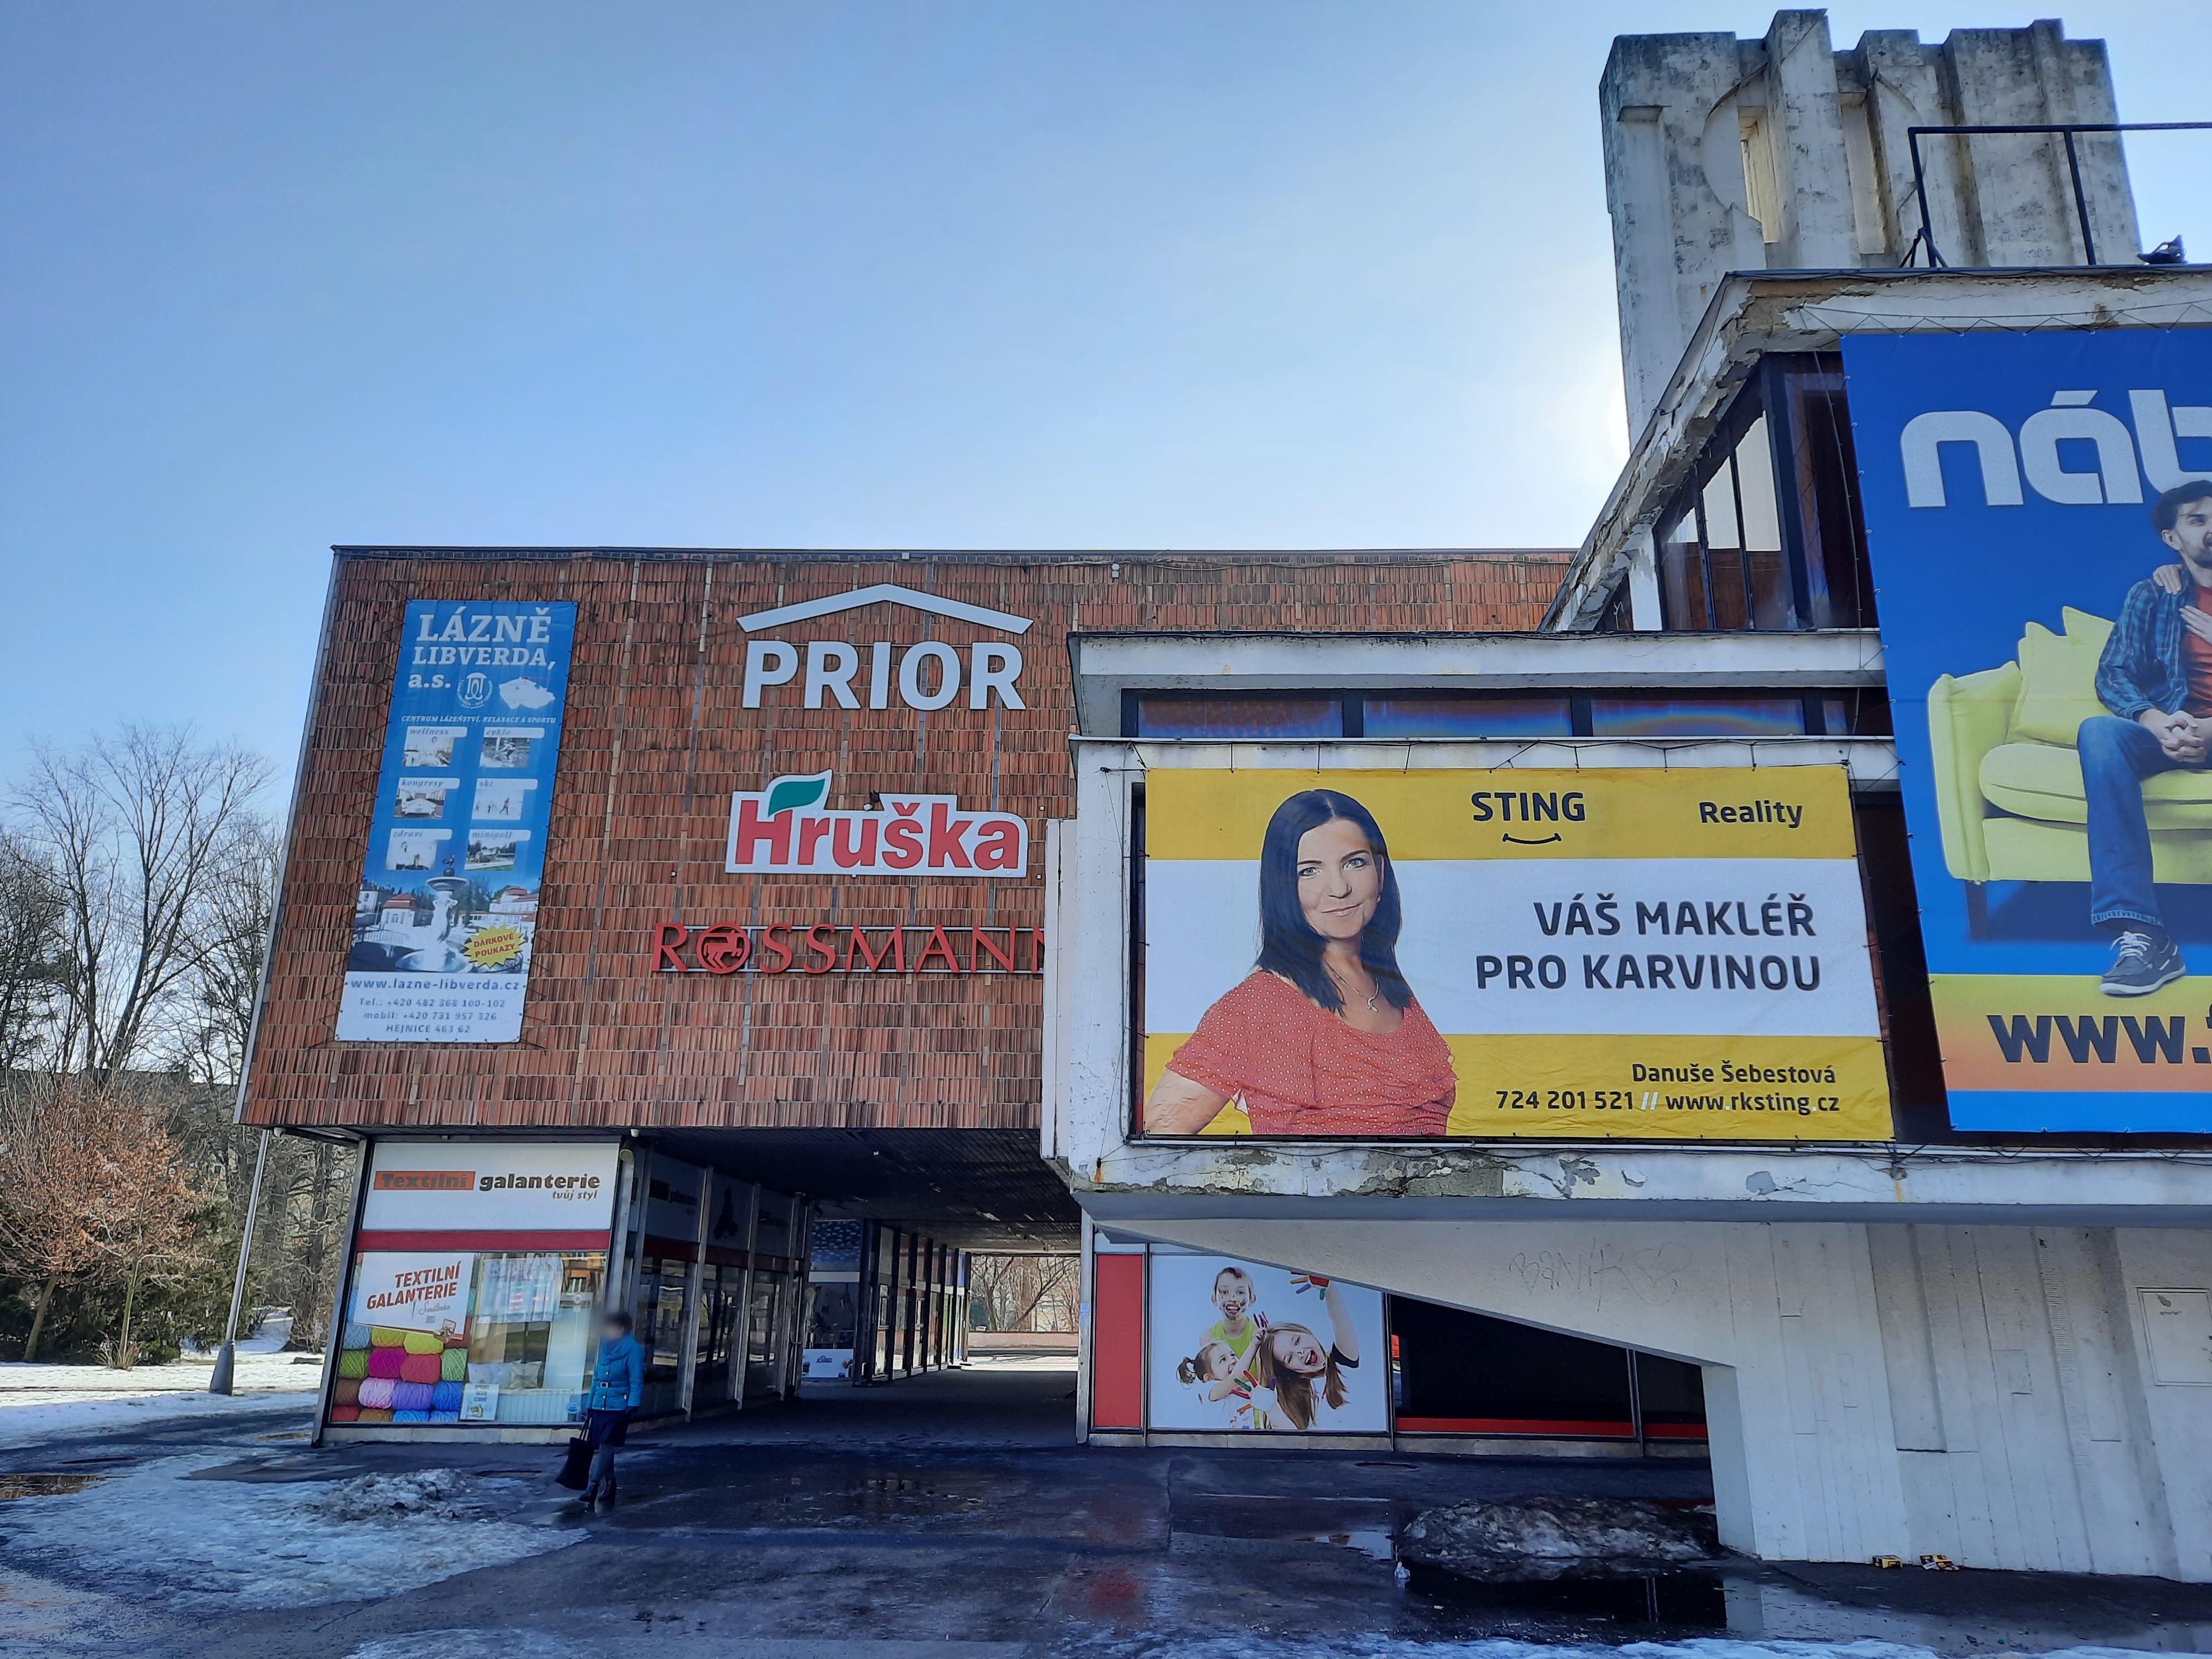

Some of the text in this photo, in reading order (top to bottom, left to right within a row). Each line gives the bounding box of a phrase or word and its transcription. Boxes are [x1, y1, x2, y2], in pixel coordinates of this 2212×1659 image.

[416, 606, 551, 643] LÁZNĚ
[412, 646, 556, 670] LIBVERDA,
[408, 673, 451, 688] a.s.
[742, 640, 1027, 710] PRIOR
[487, 728, 510, 737] cyklo
[401, 779, 444, 788] kongresy
[1471, 791, 1586, 822] STING
[1699, 800, 1803, 829] Reality
[472, 831, 513, 839] minigolf
[734, 800, 1021, 872] Hruška
[1533, 892, 1817, 937] VÁŠ MAKLÉŘ
[474, 932, 514, 947] DÁRKOVÉ
[475, 943, 515, 958] POUKAZY
[651, 921, 1045, 974] ROSSMAN
[351, 978, 520, 990] www.lazne-libverda.cz
[1475, 953, 1820, 992] PRO KARVINOU
[386, 1024, 470, 1034] HEJNICE 463 62
[1986, 1002, 2212, 1064] www.
[1632, 1059, 1837, 1084] Danuše Šebestová
[1495, 1089, 1540, 1110] 724
[1547, 1089, 1588, 1110] 201
[1594, 1090, 1634, 1110] 521
[1665, 1092, 1840, 1117] www.rksting.cz
[382, 1173, 601, 1192] Textilní galanterie
[552, 1190, 598, 1201] tvůj styl
[395, 1261, 462, 1288] TEXTILNÍ
[367, 1281, 458, 1310] GALANTERIE
